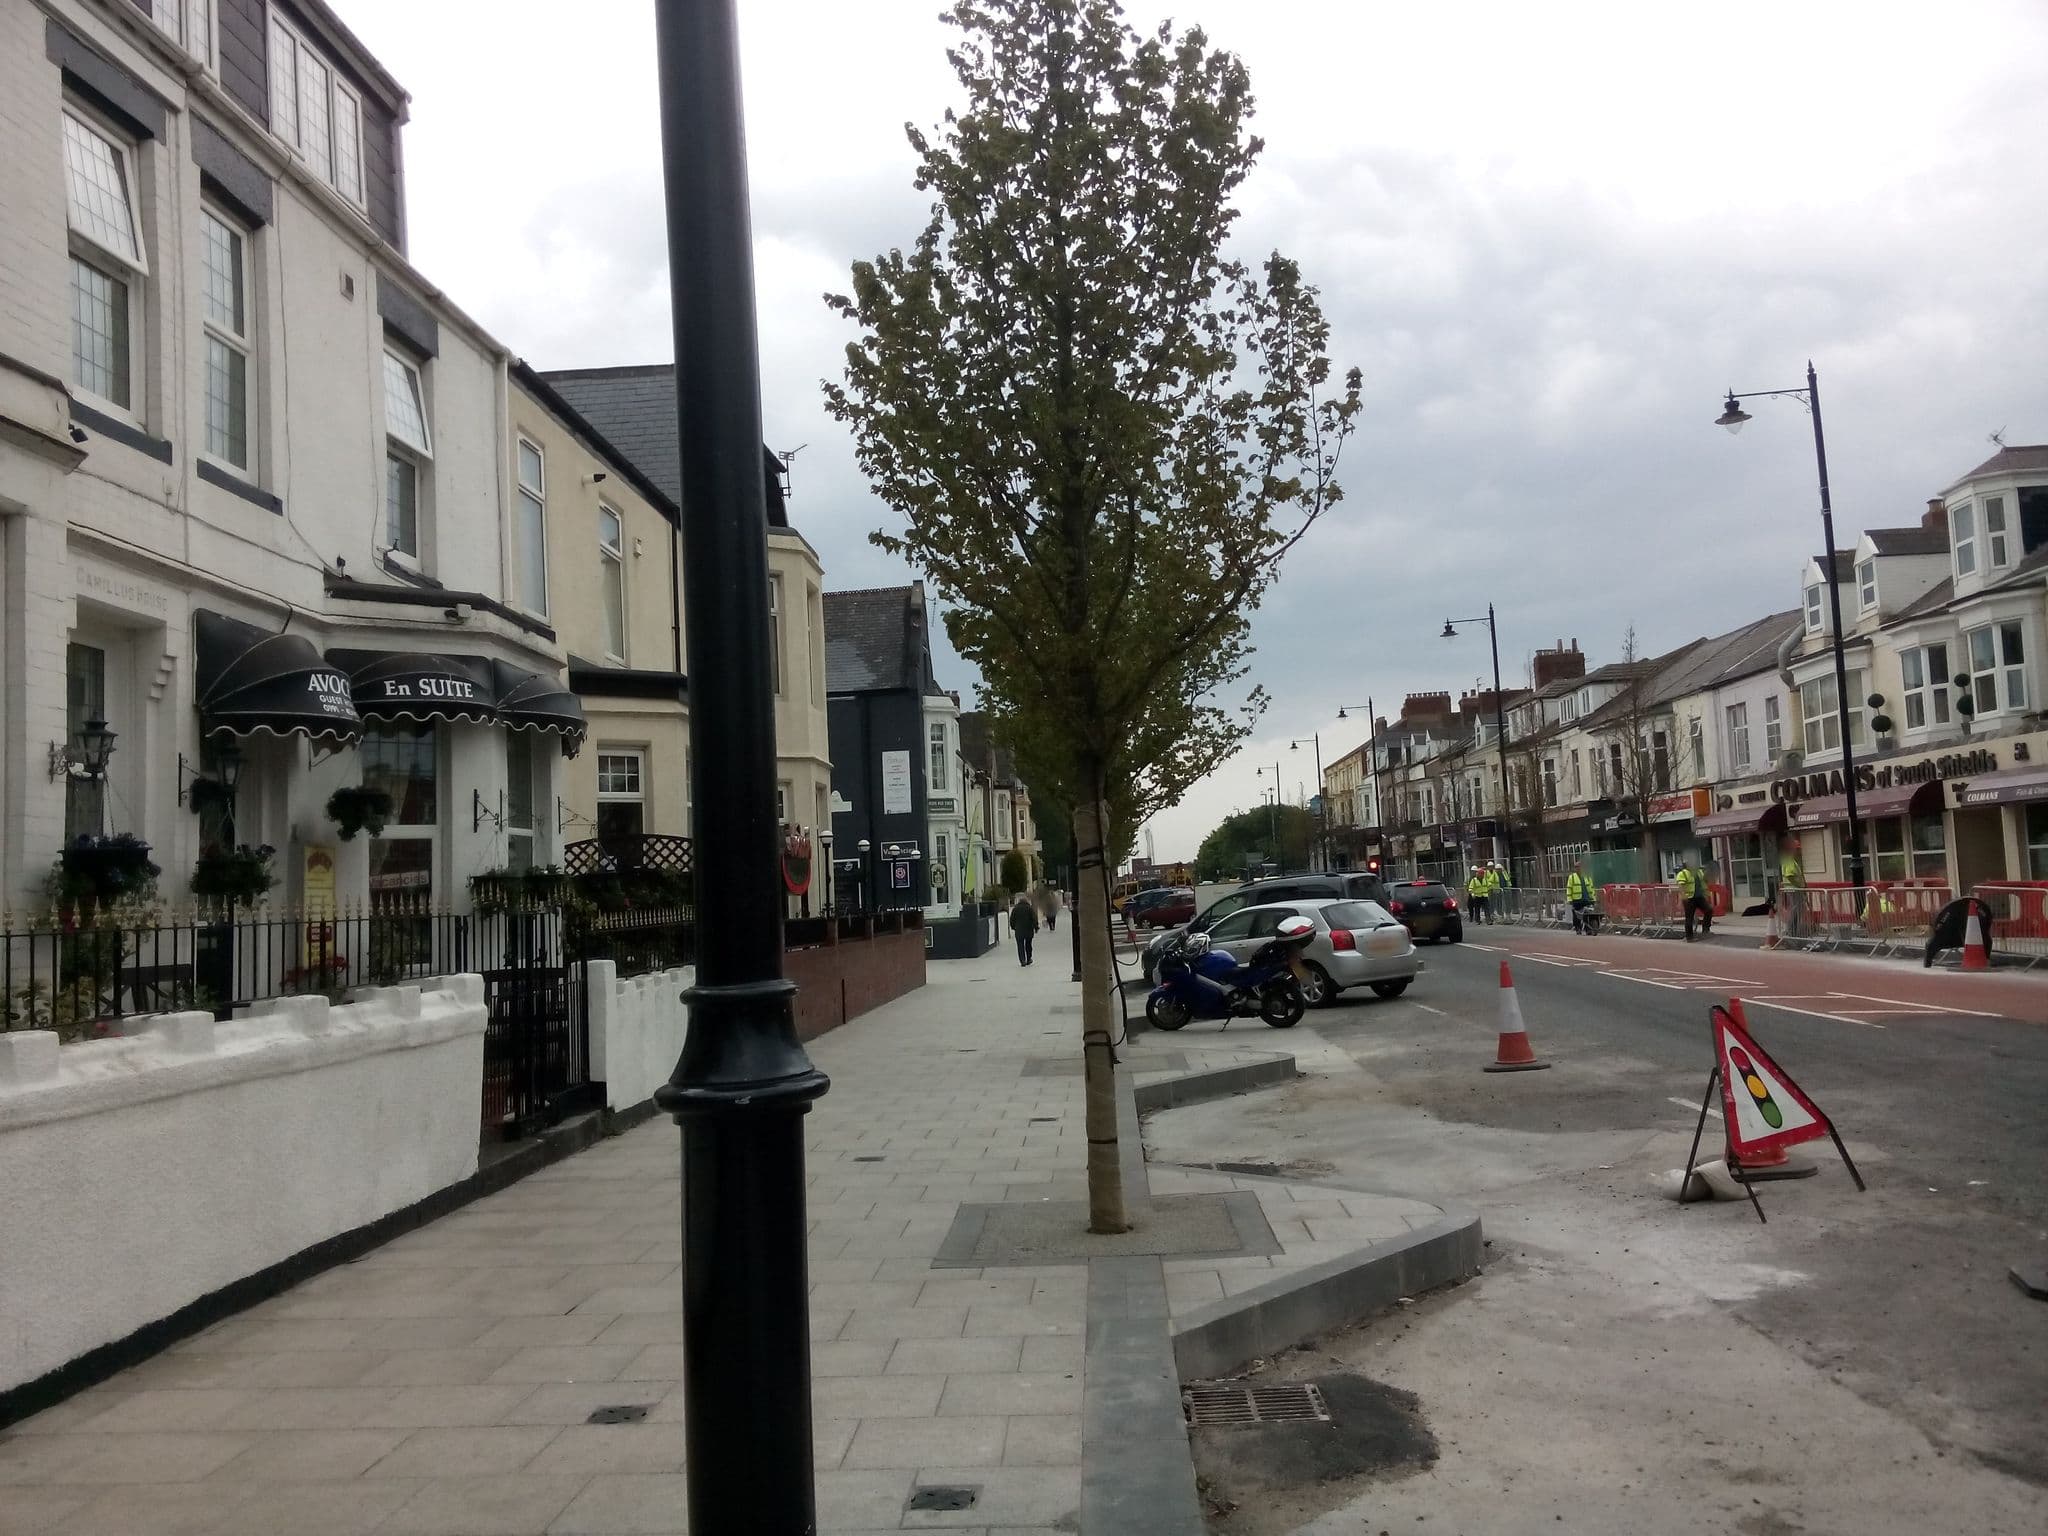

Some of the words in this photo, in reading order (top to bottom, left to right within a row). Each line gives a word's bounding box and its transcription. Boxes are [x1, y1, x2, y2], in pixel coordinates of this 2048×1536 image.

[308, 673, 351, 698] AVOC
[384, 680, 411, 697] En
[419, 678, 474, 698] SUITE
[1770, 764, 1876, 803] COLMANS
[1876, 765, 1892, 788] of
[1894, 758, 1937, 785] South
[1936, 748, 1998, 778] Shields
[1967, 791, 1999, 802] COLMANS
